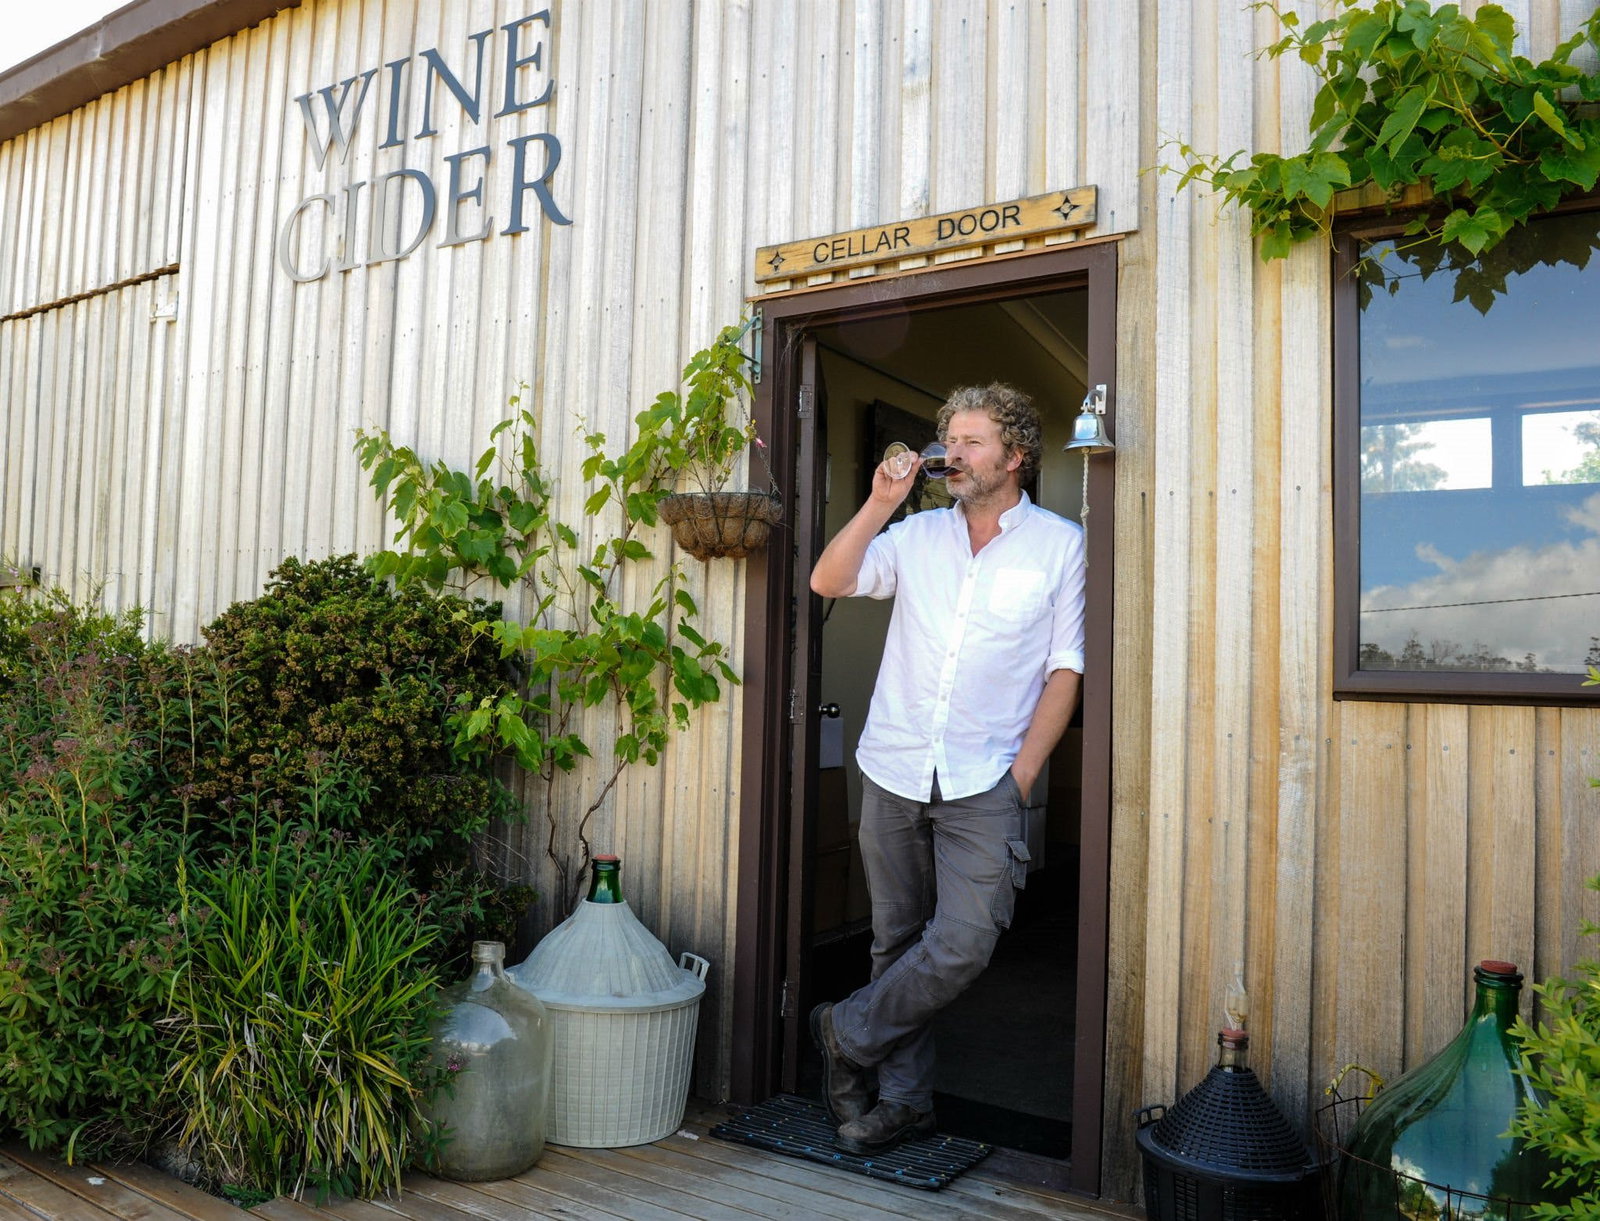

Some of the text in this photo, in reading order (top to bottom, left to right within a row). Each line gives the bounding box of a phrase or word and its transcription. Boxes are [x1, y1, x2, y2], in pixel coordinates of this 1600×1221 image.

[294, 9, 554, 172] WINE
[279, 132, 574, 283] CIDER
[813, 204, 1021, 264] CELLAR DOOR
